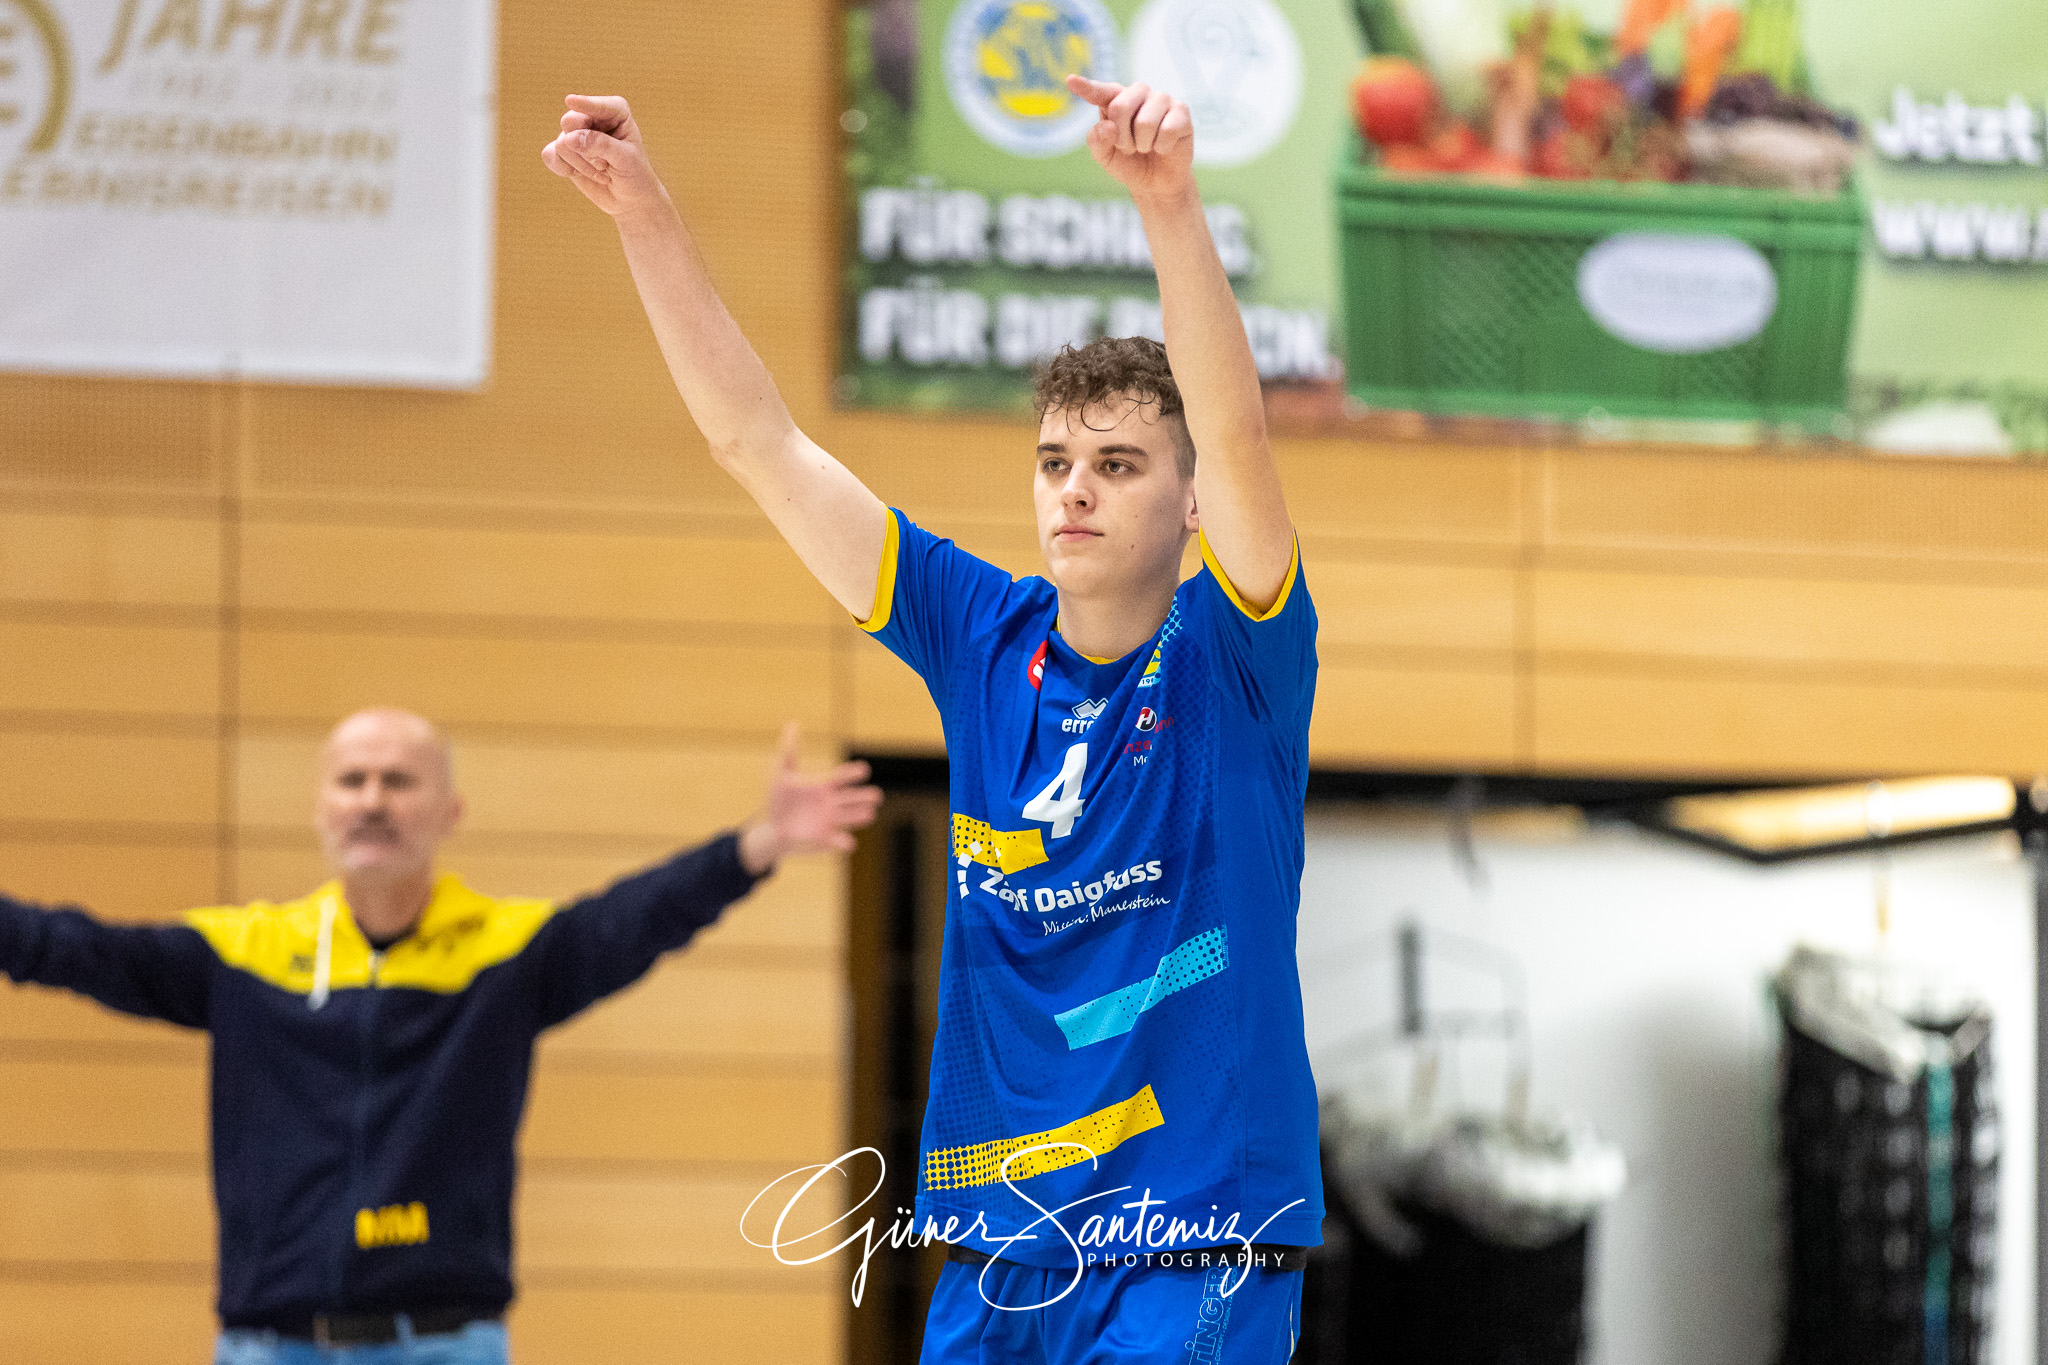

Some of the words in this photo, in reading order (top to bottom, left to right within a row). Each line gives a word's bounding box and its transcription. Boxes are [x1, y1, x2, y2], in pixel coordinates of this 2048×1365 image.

[98, 0, 402, 74] JAHRE
[1874, 86, 2041, 166] Jetzt
[860, 176, 988, 263] FÜR
[860, 276, 988, 366] FÜR
[1022, 742, 1088, 839] 4
